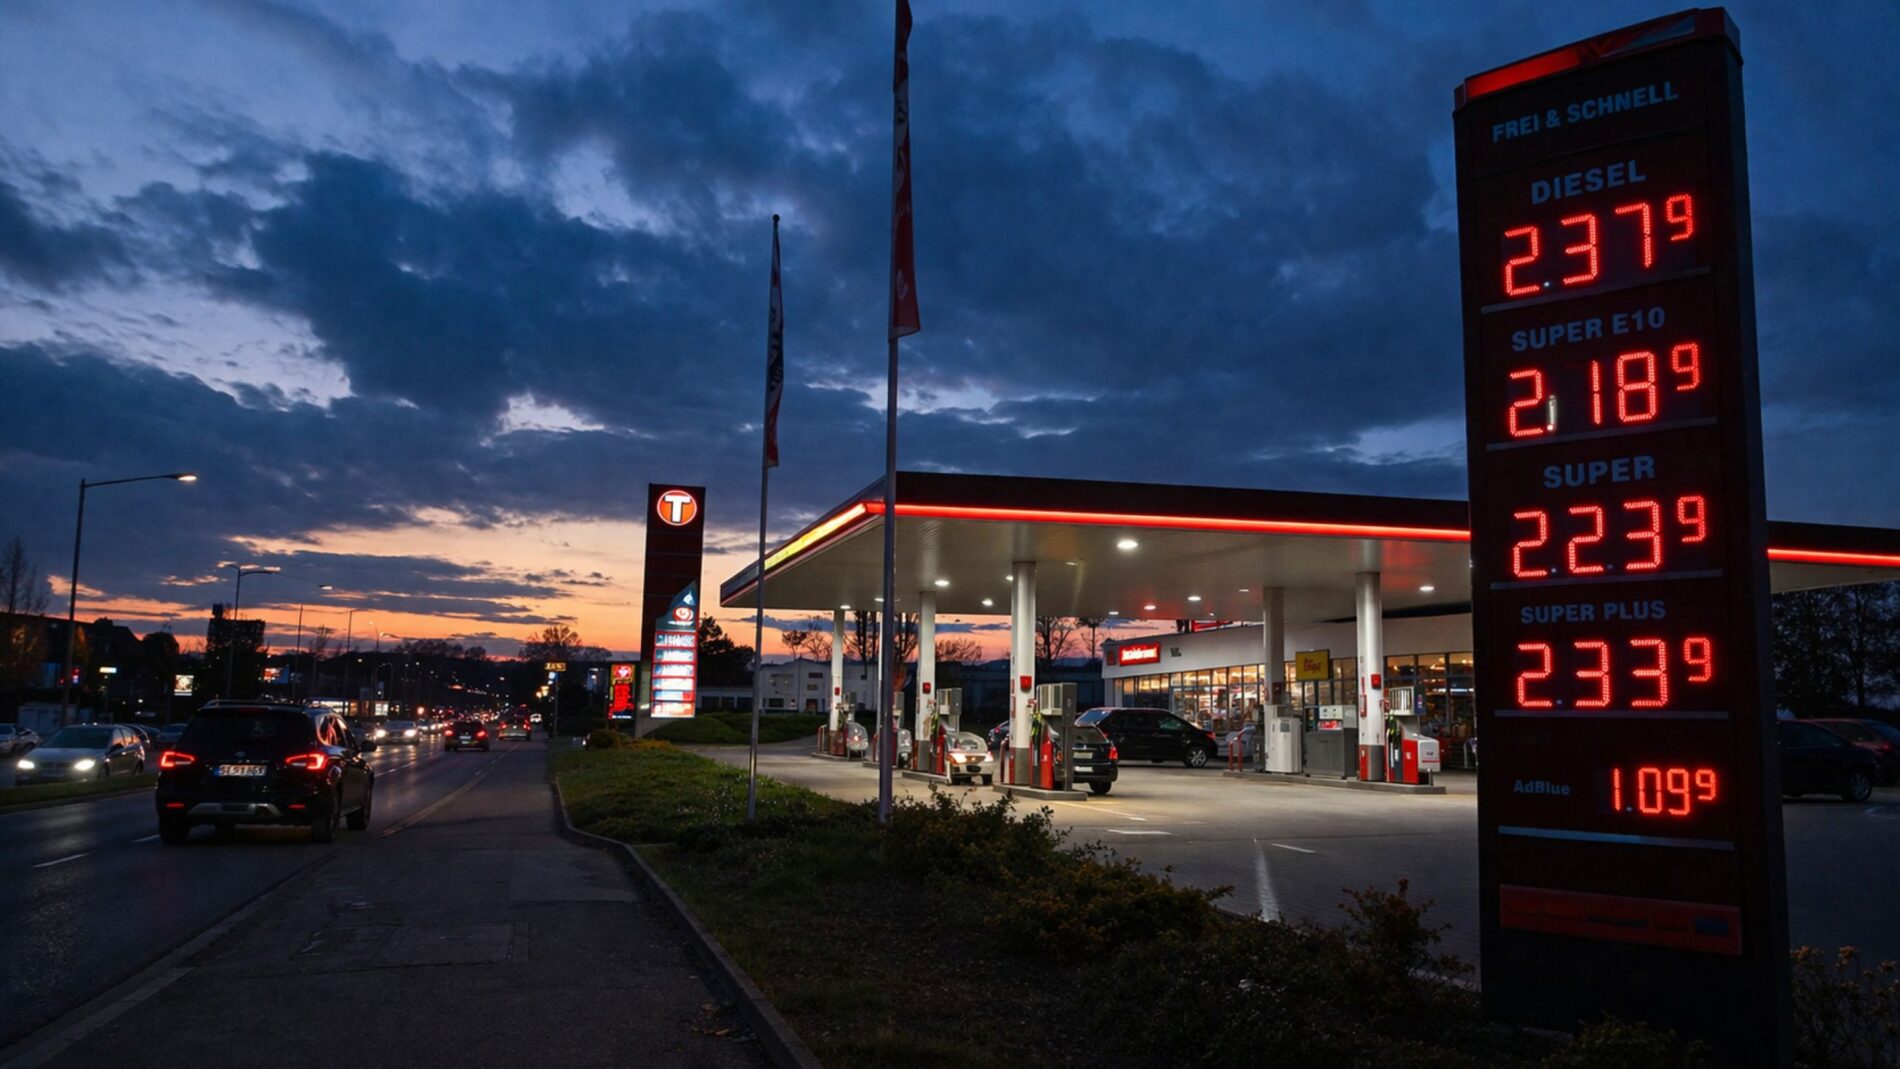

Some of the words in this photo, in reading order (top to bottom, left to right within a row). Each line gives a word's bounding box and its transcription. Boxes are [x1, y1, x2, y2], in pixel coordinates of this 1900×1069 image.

[1492, 116, 1540, 143] FREI
[1545, 110, 1561, 128] &
[1568, 81, 1679, 125] SCHNELL
[1531, 161, 1646, 205] DIESEL
[1512, 318, 1603, 352] SUPER
[1612, 307, 1666, 334] E10
[1544, 455, 1656, 489] SUPER
[665, 495, 691, 523] T
[1521, 604, 1595, 624] SUPER
[1605, 600, 1667, 620] PLUS
[1513, 780, 1570, 796] AdBlue
